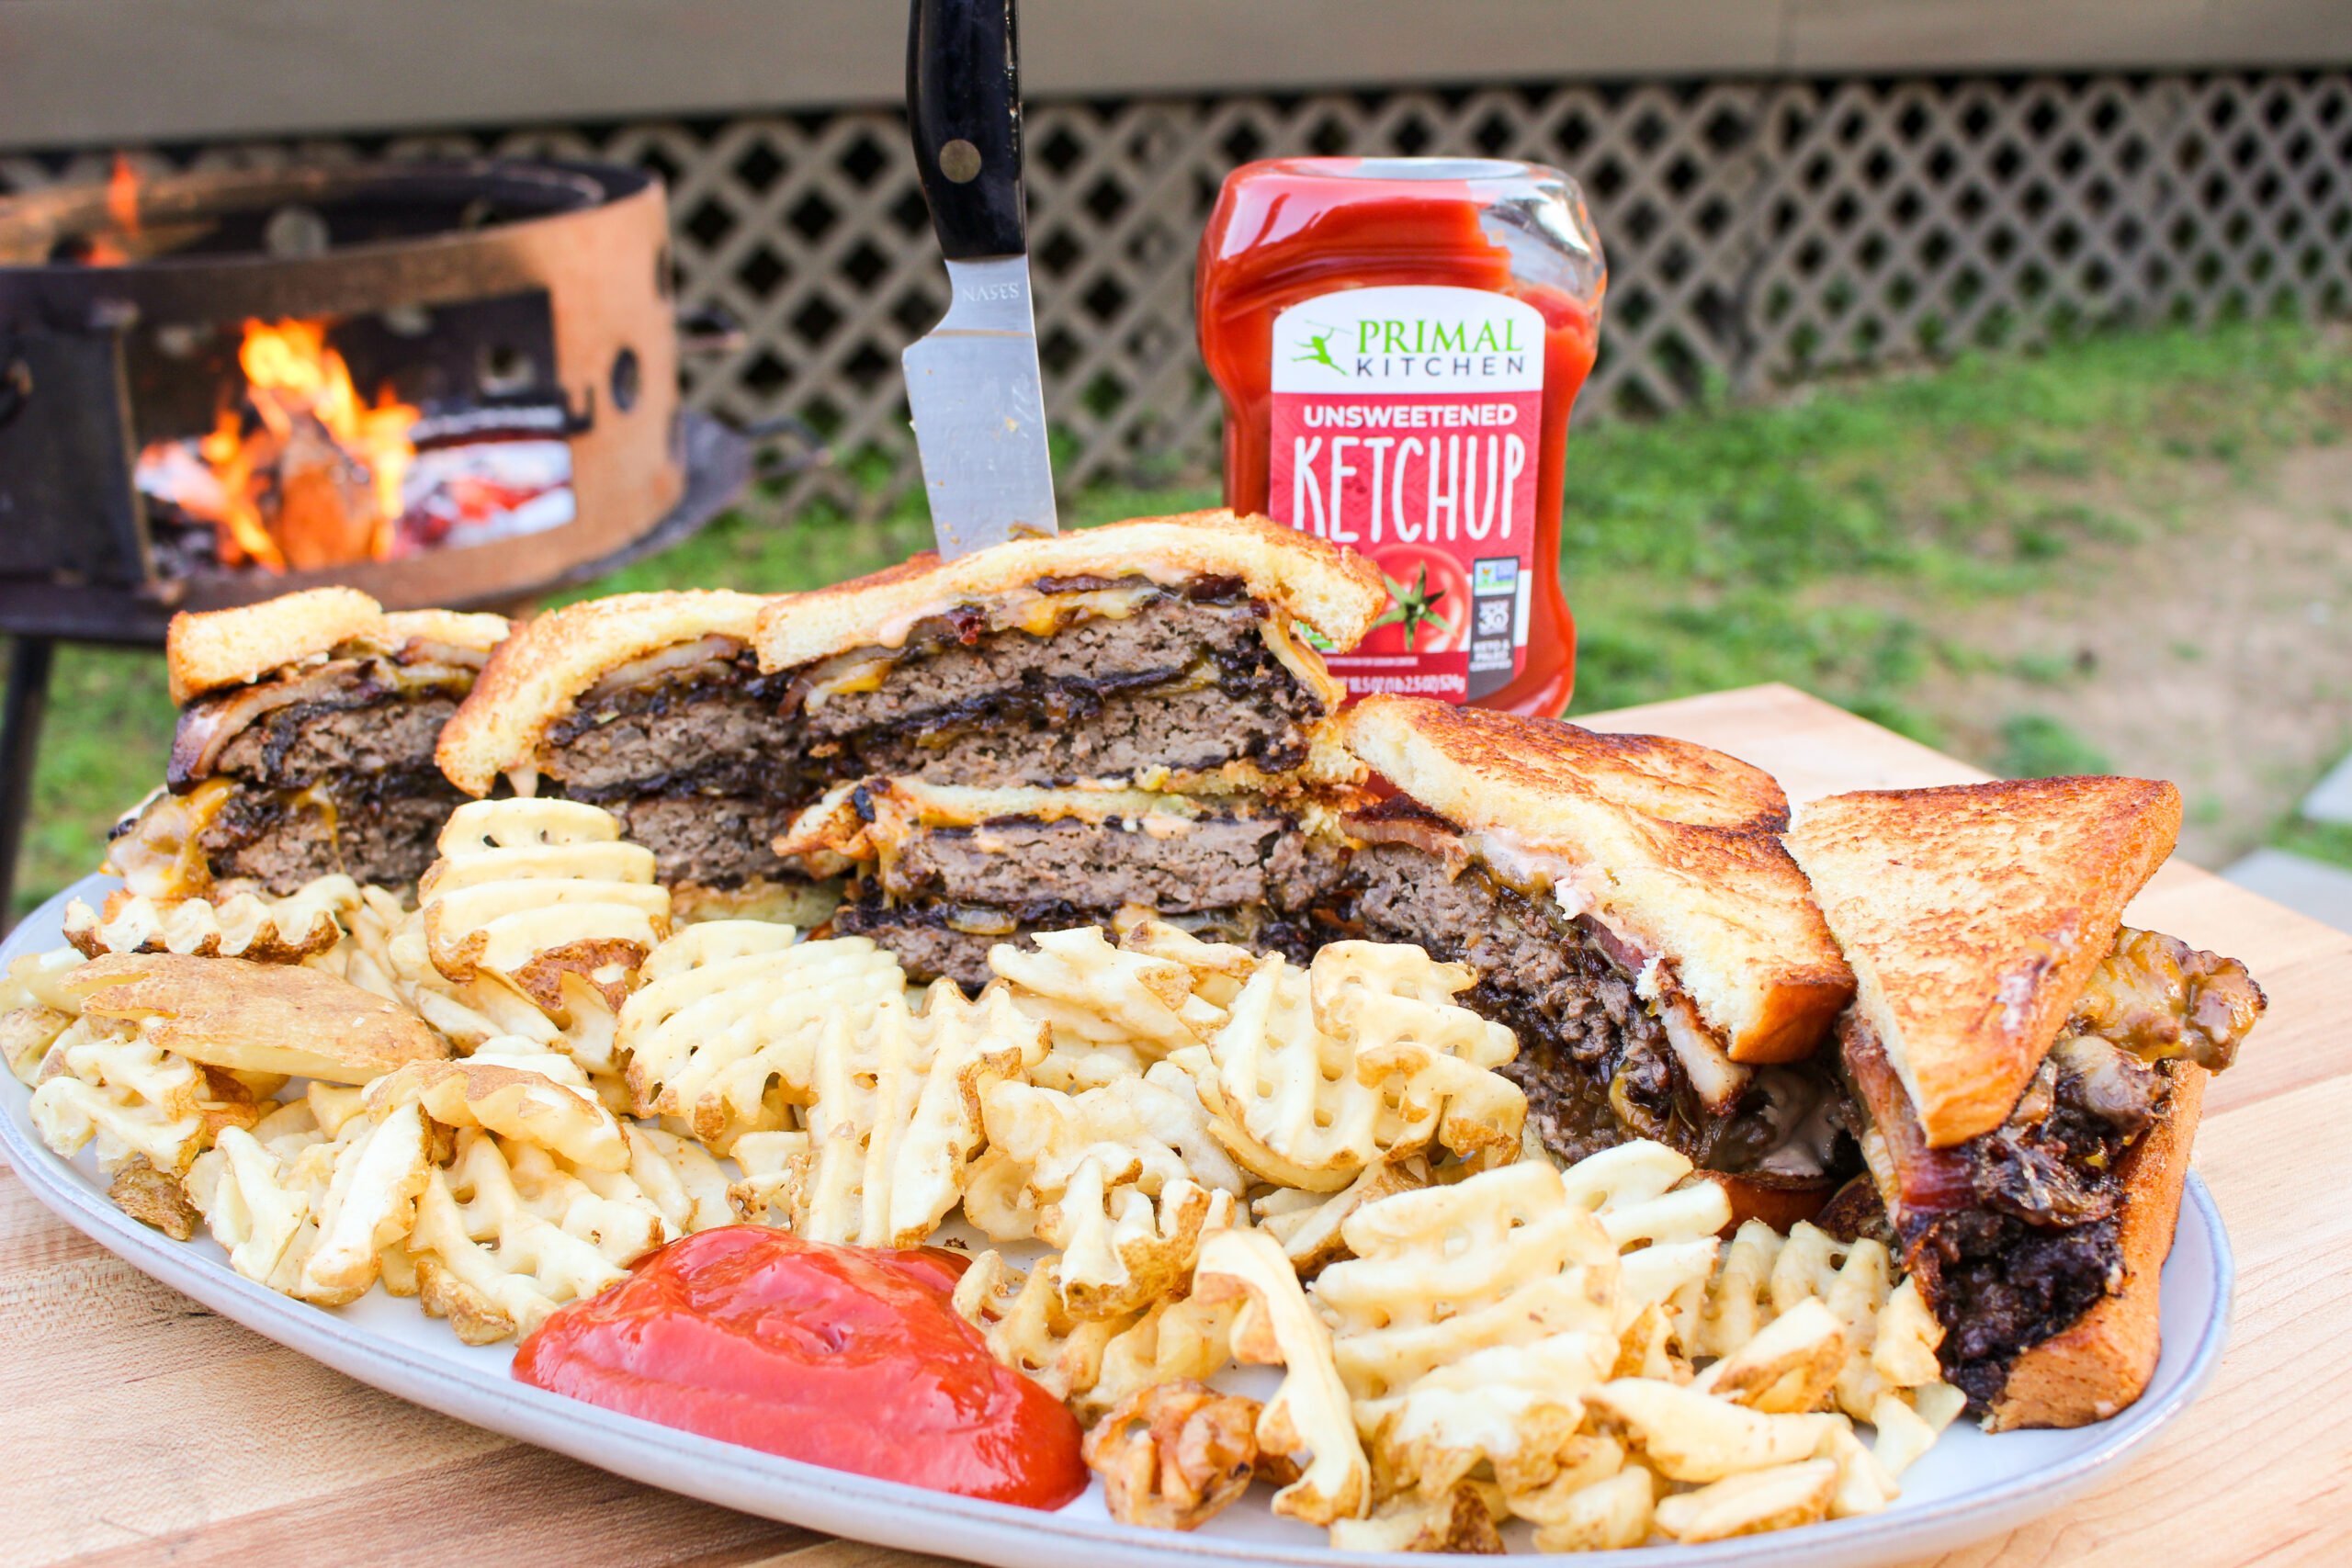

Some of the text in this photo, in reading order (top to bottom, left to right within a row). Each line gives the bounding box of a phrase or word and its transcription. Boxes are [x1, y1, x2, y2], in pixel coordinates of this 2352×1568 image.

[1356, 319, 1523, 354] PRIMAL
[1356, 355, 1524, 378] KITCHEN
[1303, 403, 1518, 428] UNSWEETENED
[1293, 433, 1526, 544] KETCHUP
